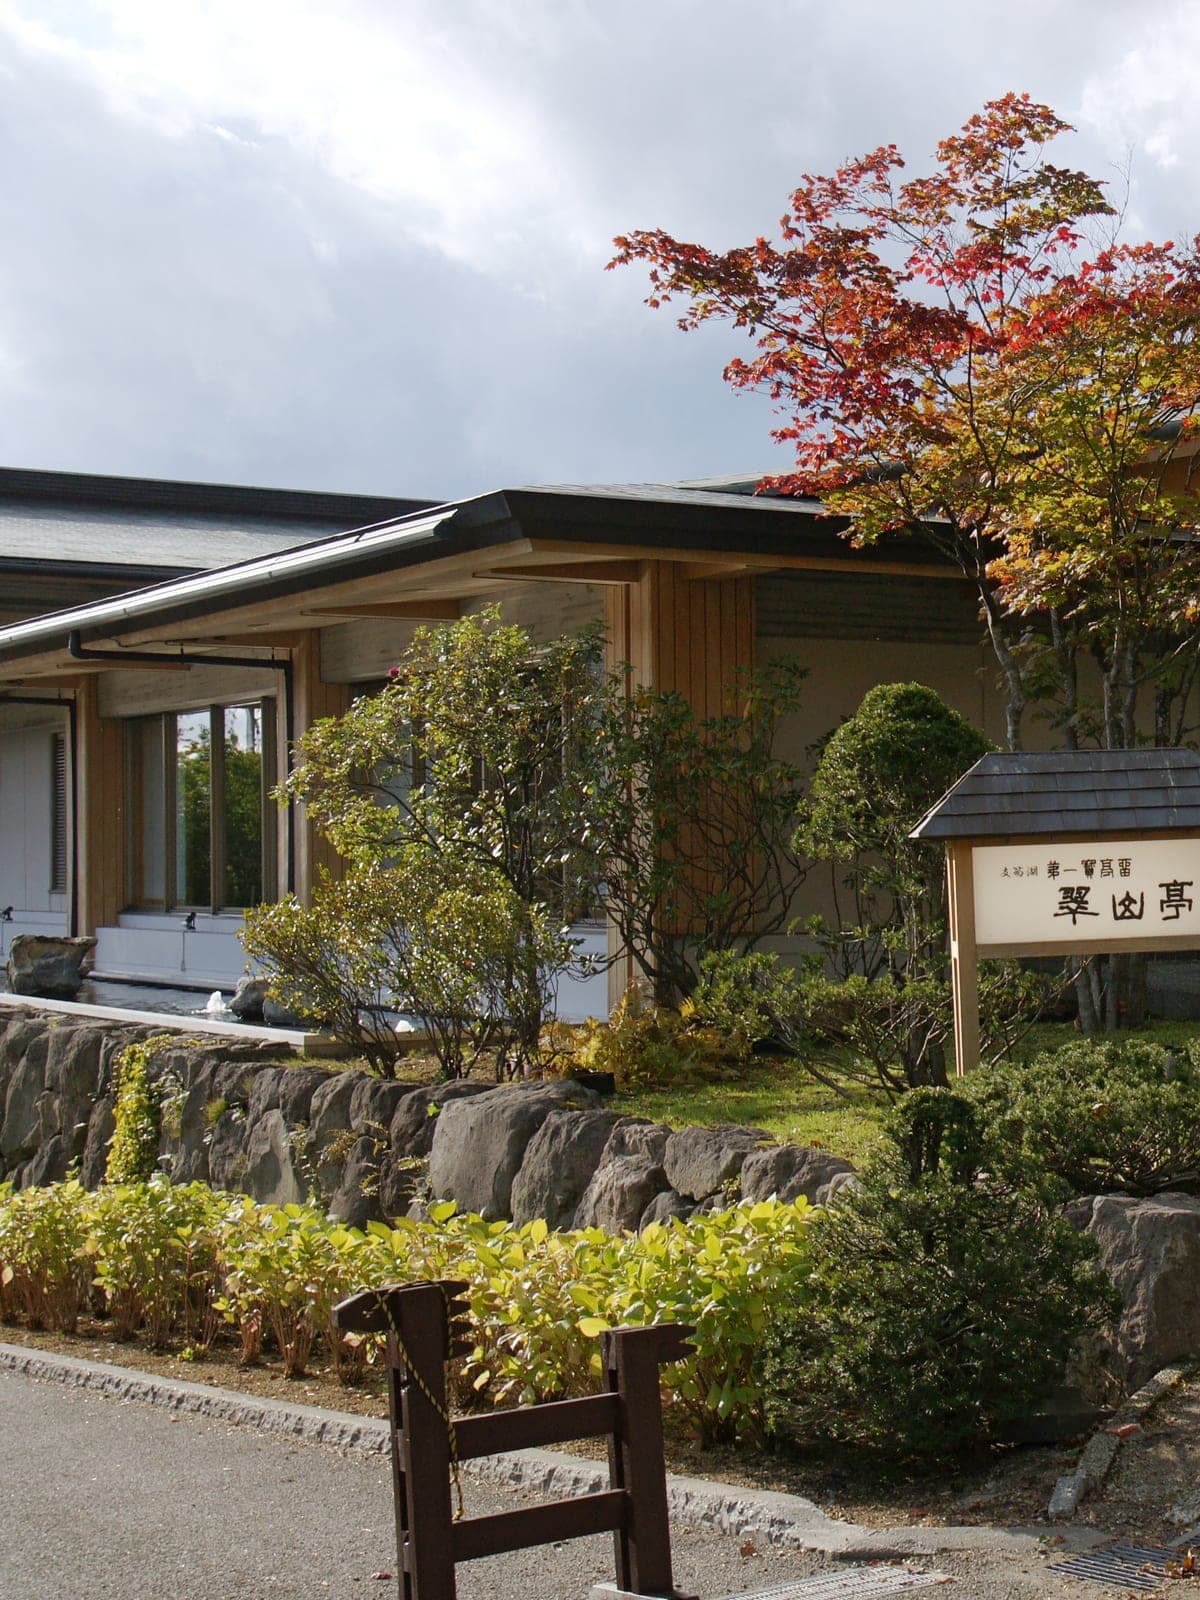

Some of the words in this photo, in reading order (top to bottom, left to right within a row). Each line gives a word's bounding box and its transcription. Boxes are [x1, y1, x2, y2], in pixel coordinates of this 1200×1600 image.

[1000, 865, 1039, 879] 支笏湖
[1053, 879, 1194, 926] 翠山亭
